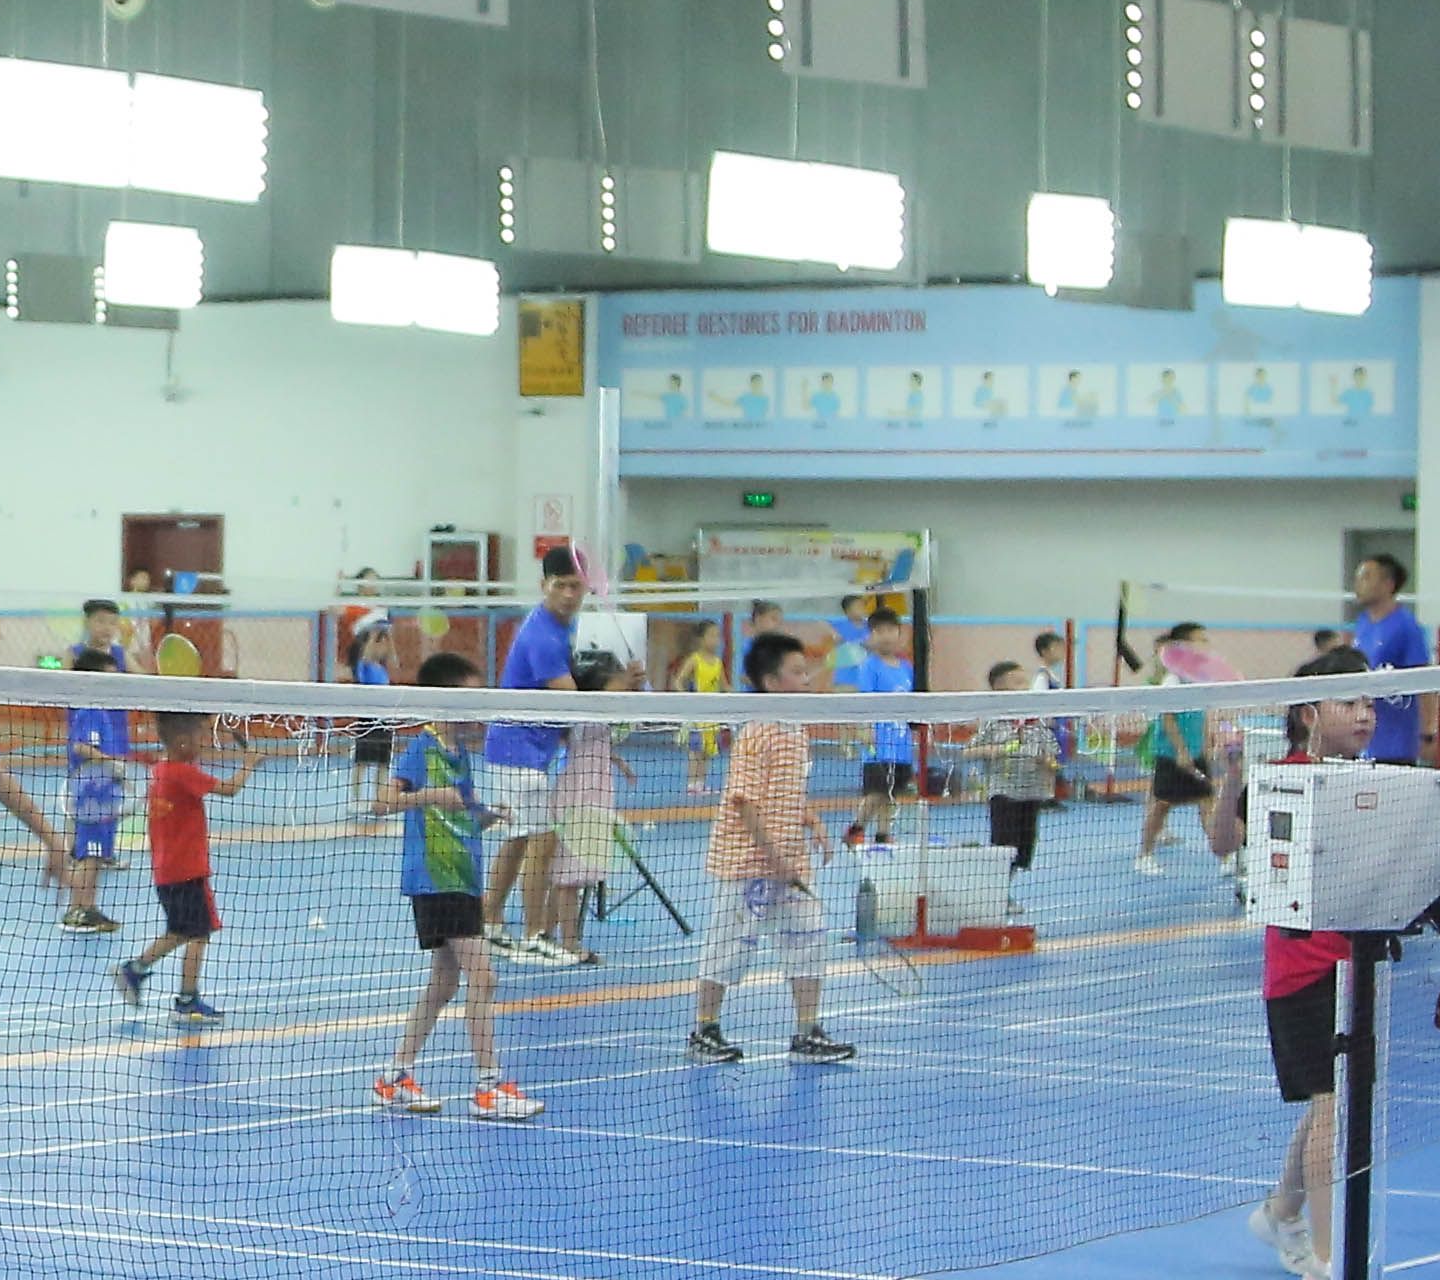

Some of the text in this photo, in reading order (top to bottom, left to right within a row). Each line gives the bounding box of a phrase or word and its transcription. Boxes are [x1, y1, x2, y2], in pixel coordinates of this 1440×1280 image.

[697, 311, 780, 336] GESTURES
[787, 310, 821, 335] FOR
[826, 308, 927, 333] BADMINTON
